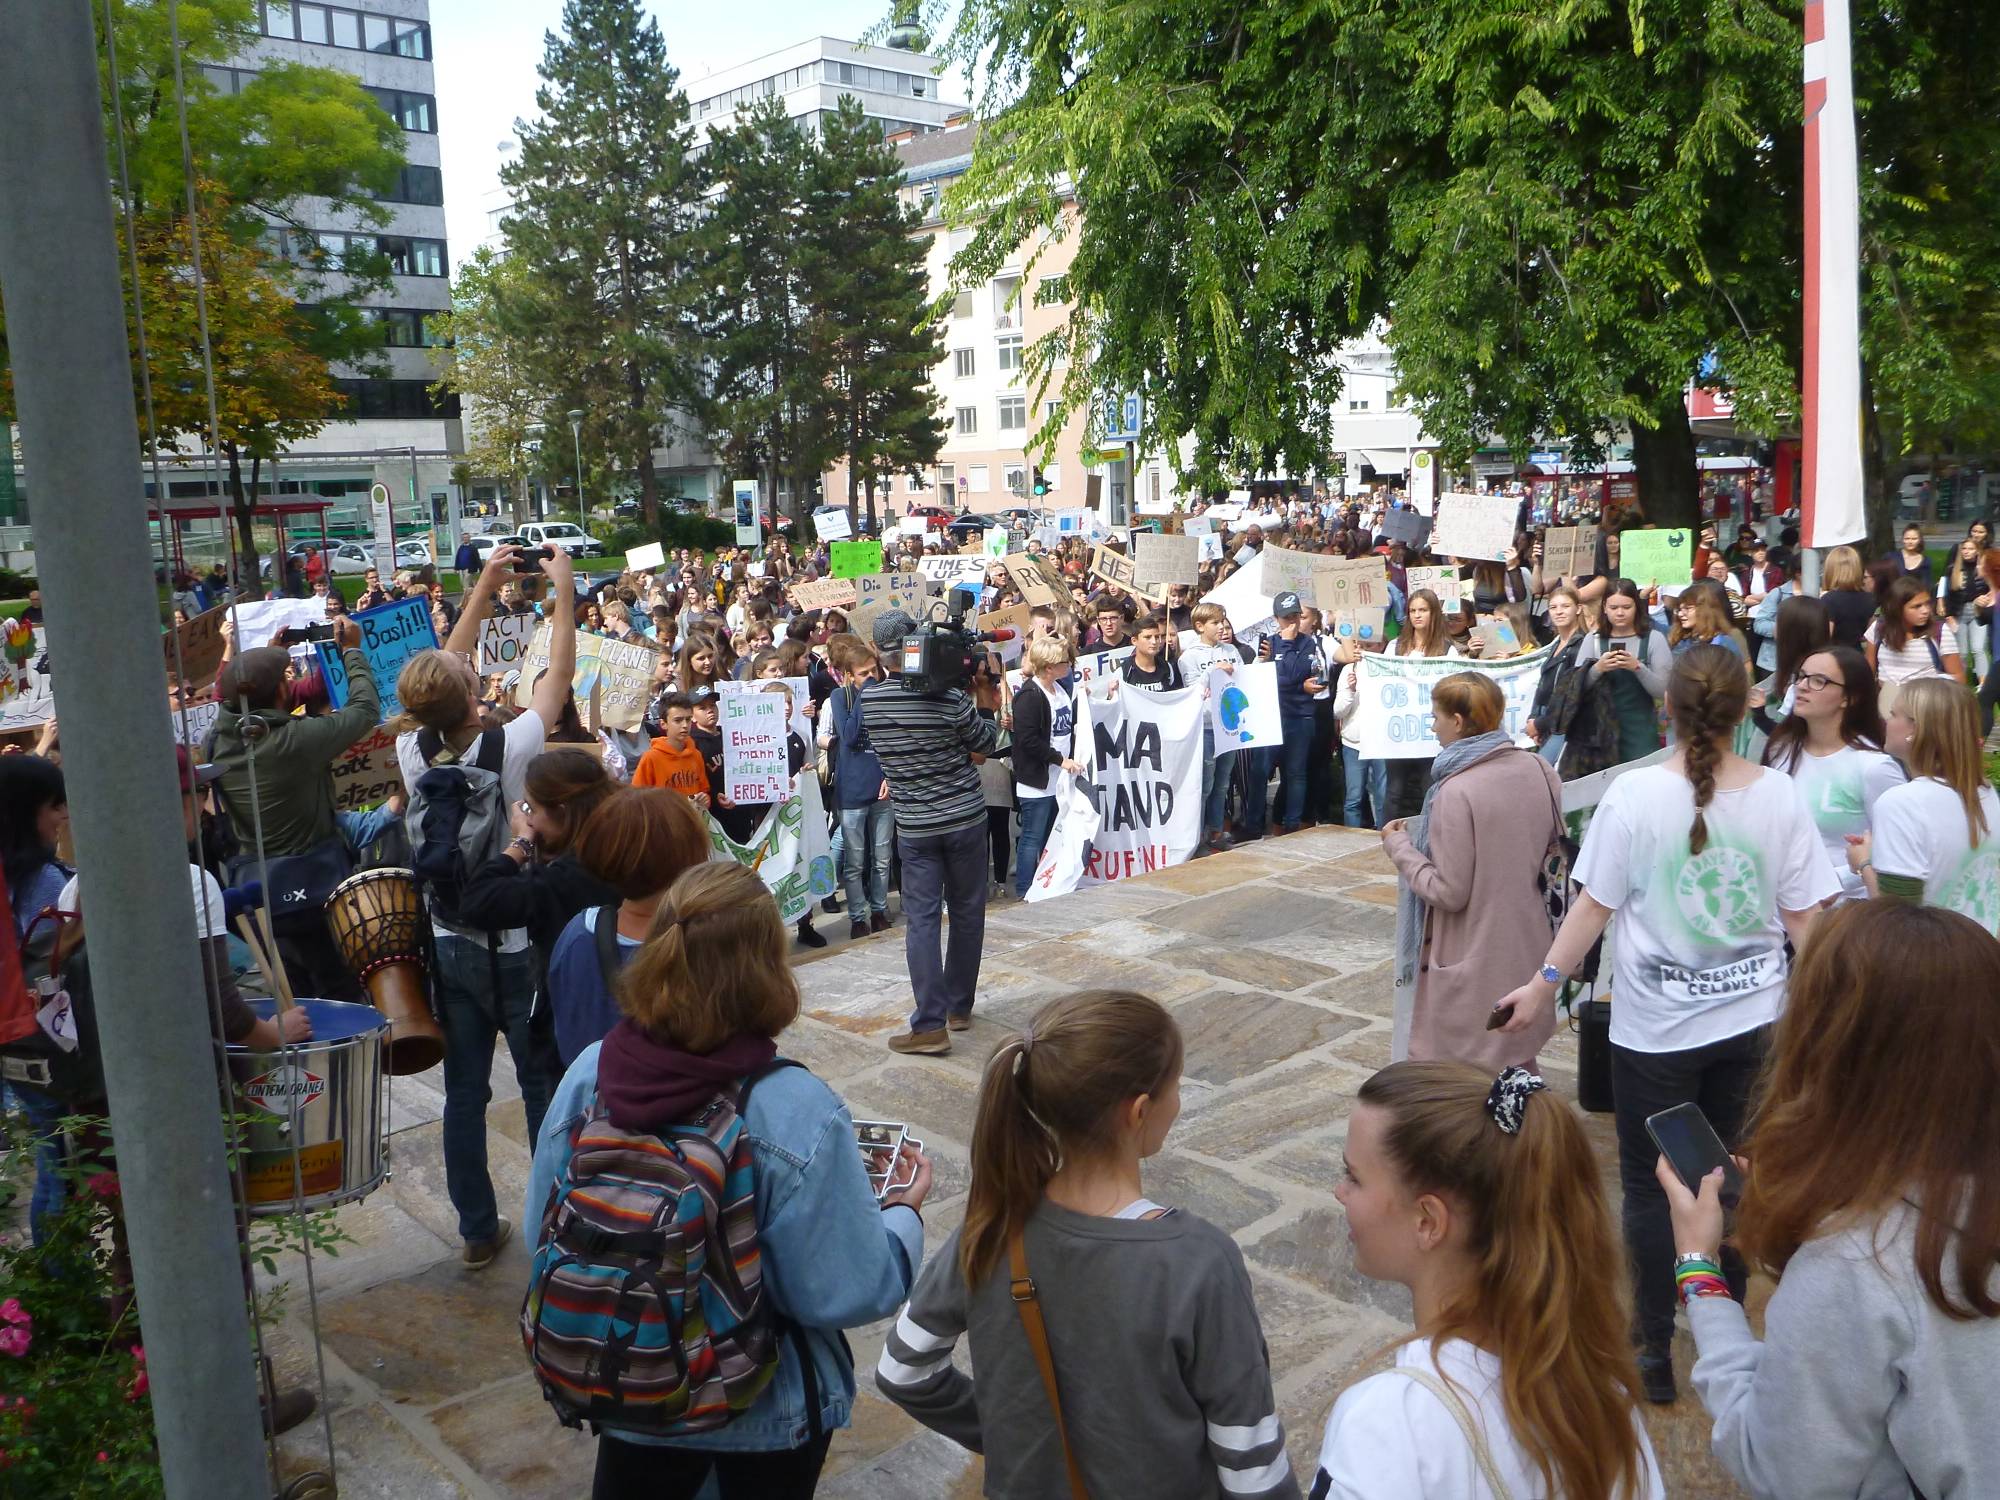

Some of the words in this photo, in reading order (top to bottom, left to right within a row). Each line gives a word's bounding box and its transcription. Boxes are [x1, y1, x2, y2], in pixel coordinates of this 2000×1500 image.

[922, 557, 986, 572] TIME'S
[863, 578, 881, 593] Die
[891, 575, 919, 590] Erde
[933, 570, 963, 580] UP
[1408, 567, 1433, 584] GELD
[362, 603, 428, 650] Basti!!
[486, 613, 529, 640] ACT
[991, 614, 1016, 630] WAKE
[598, 638, 660, 675] PLANET
[613, 672, 643, 689] YOU
[606, 690, 641, 709] GIVE
[1380, 682, 1409, 708] OB
[1387, 713, 1437, 743] ODE
[731, 731, 777, 747] Ehren-
[1093, 717, 1161, 771] MA
[738, 750, 774, 760] mann
[778, 747, 786, 761] &
[330, 753, 374, 778] att
[734, 784, 769, 802] ERDE,
[1095, 777, 1171, 830] TAND
[1662, 957, 1768, 983] KLAGENFURT
[1687, 976, 1761, 996] CELOVEC
